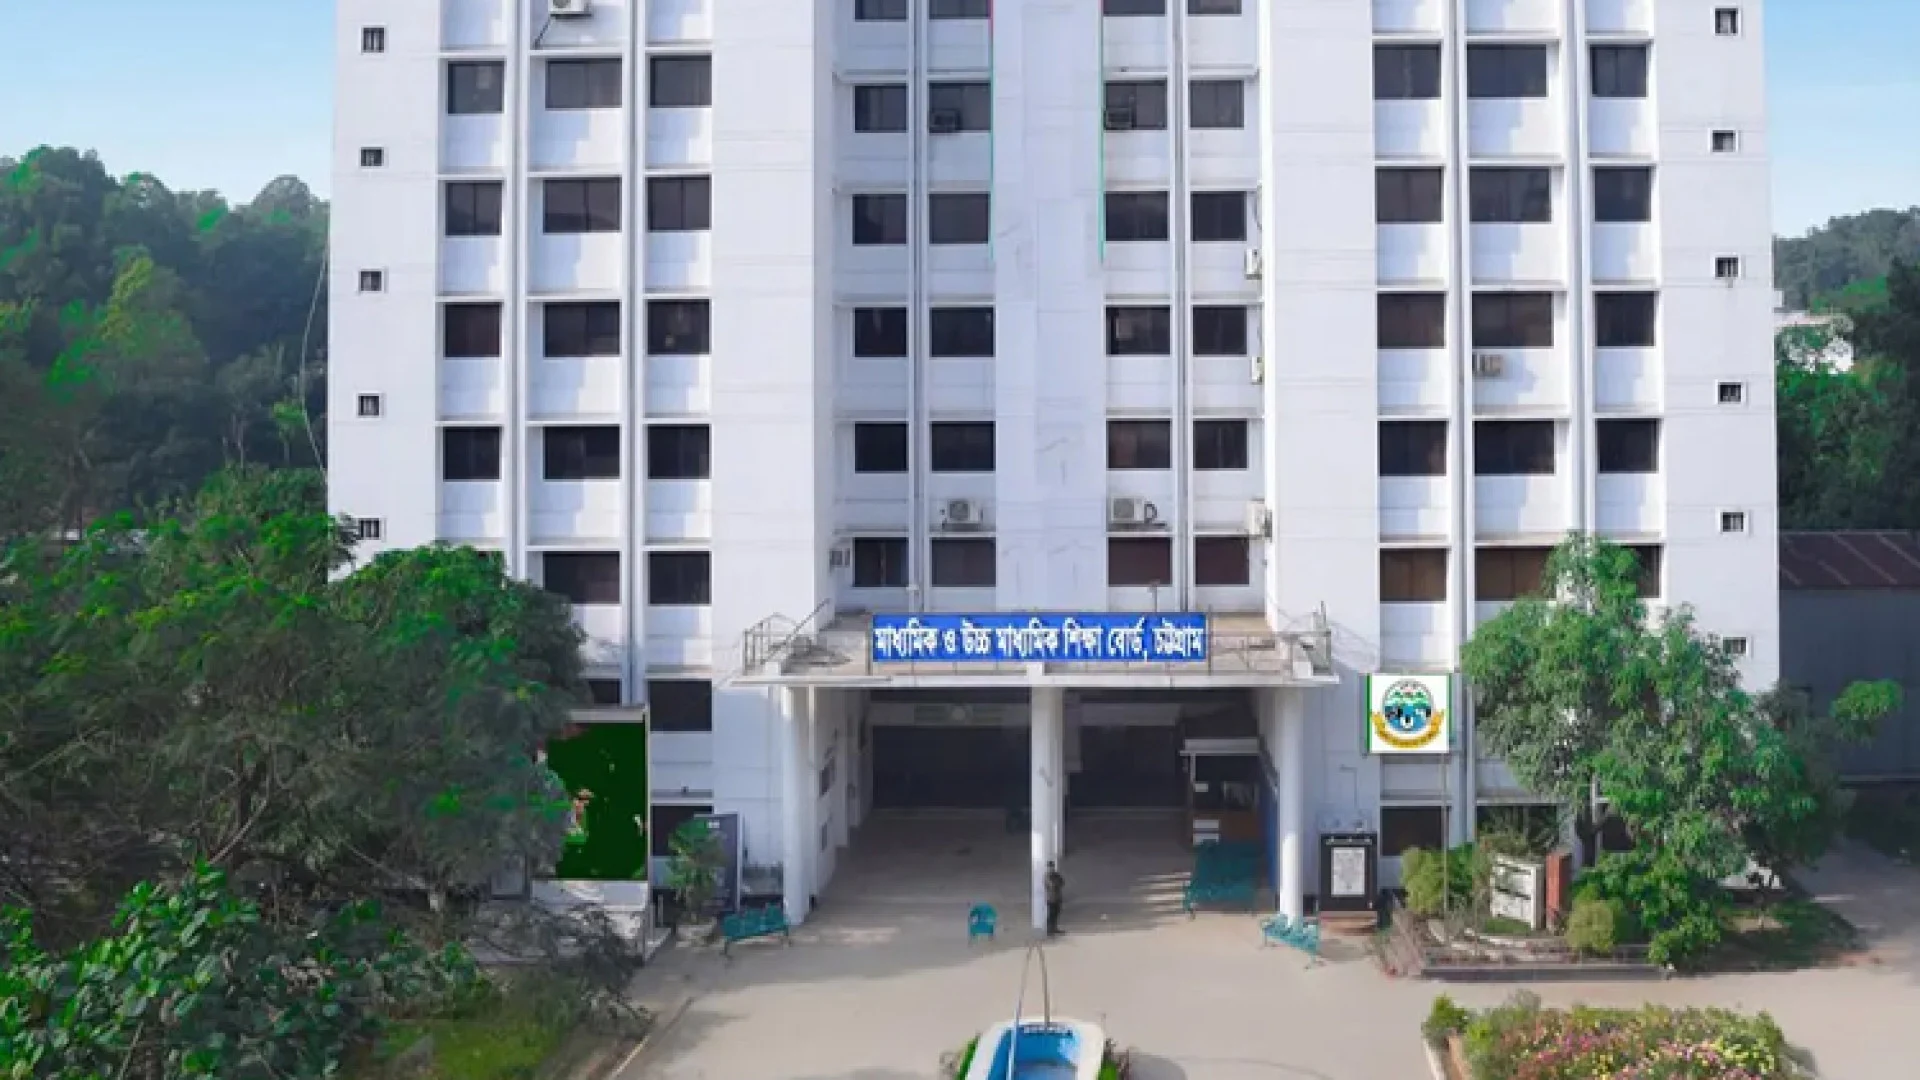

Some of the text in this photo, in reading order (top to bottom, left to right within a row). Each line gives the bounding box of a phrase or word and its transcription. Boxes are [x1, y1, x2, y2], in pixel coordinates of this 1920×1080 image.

[874, 617, 938, 657] মাধ্যমিক
[943, 628, 956, 654] ও
[960, 617, 992, 654] উচ্চ
[995, 617, 1059, 657] মাধ্যমিক
[1062, 617, 1104, 657] শিক্ষা
[1152, 617, 1204, 657] চট্টগ্রাম
